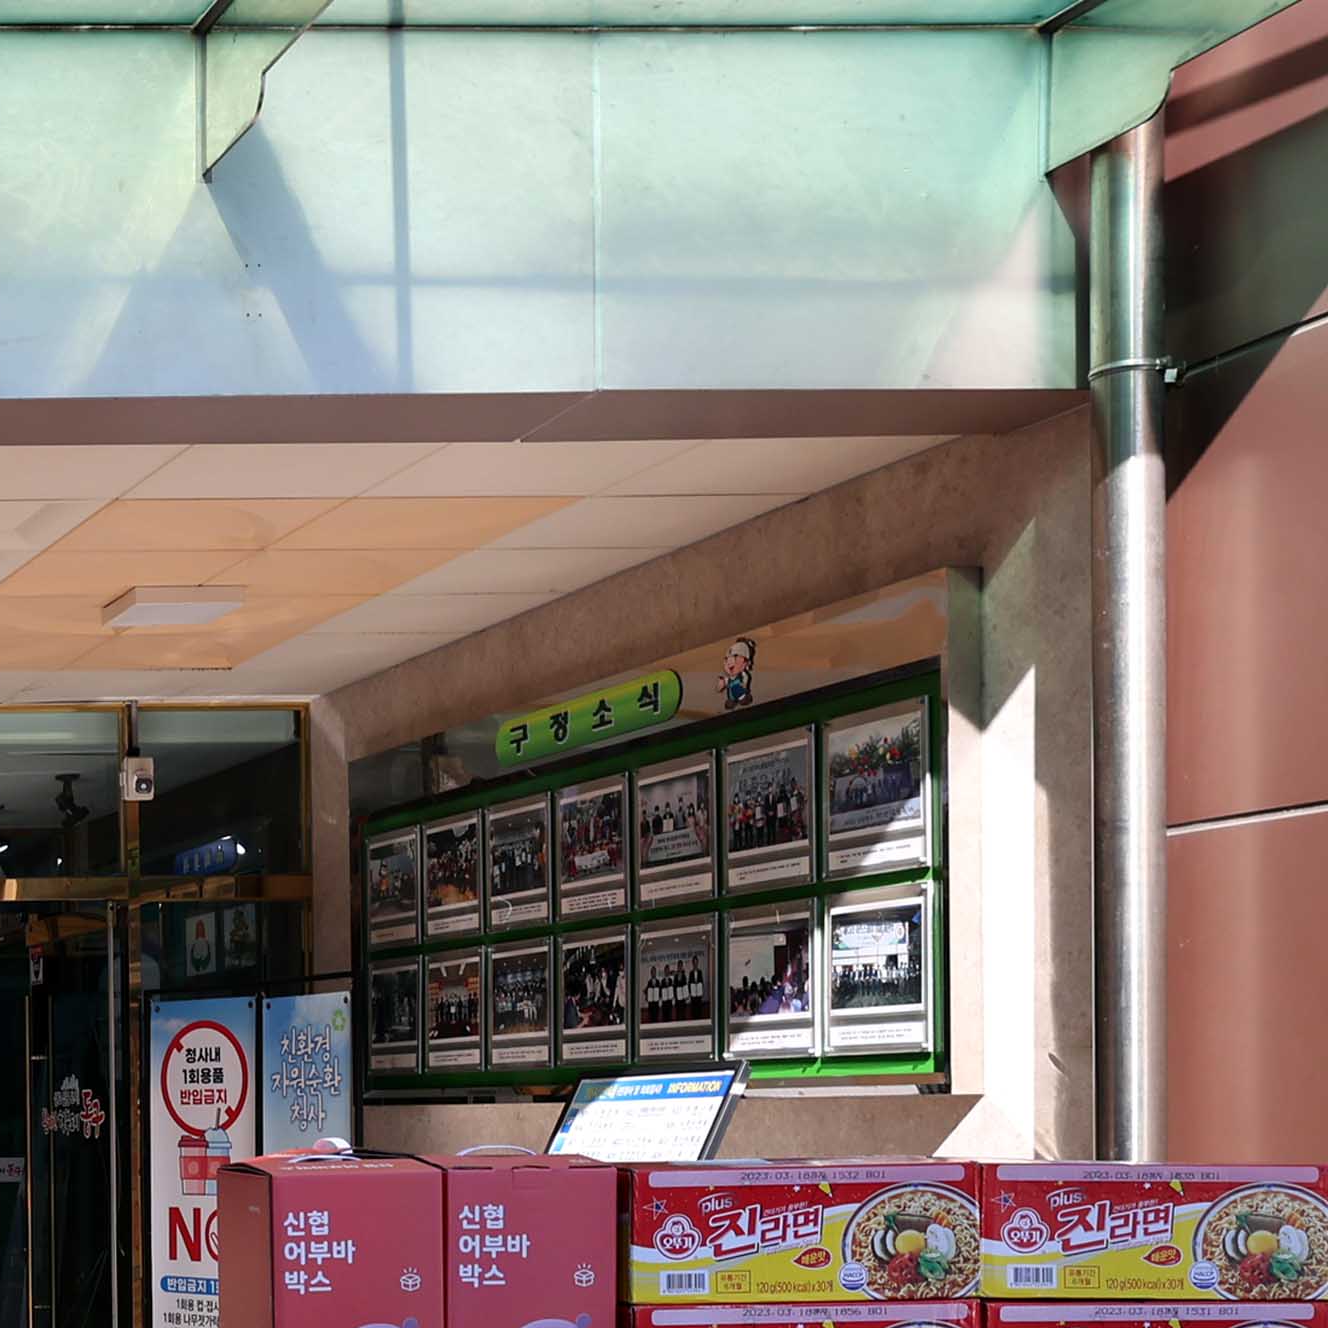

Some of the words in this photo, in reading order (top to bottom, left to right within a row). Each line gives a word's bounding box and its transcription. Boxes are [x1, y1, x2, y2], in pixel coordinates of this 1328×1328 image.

[185, 1047, 221, 1064] 청사내
[280, 1025, 331, 1064] 친환경
[182, 1067, 224, 1085] 1회용품
[271, 1060, 342, 1098] 자원순환
[667, 1080, 723, 1093] INFORMATION
[180, 1088, 227, 1105] 반입금지
[290, 1094, 326, 1132] 청사
[283, 1210, 330, 1237] 신협
[458, 1204, 505, 1230] 신협
[707, 1203, 823, 1262] 진라면
[1010, 1229, 1042, 1244] 오뚜기
[1056, 1201, 1175, 1260] 진라면
[284, 1240, 356, 1265] 어부바
[458, 1234, 531, 1259] 어부바
[662, 1237, 693, 1251] 오뚜기
[167, 1277, 207, 1293] 반입금지
[284, 1270, 333, 1295] 박스
[459, 1263, 507, 1288] 박스
